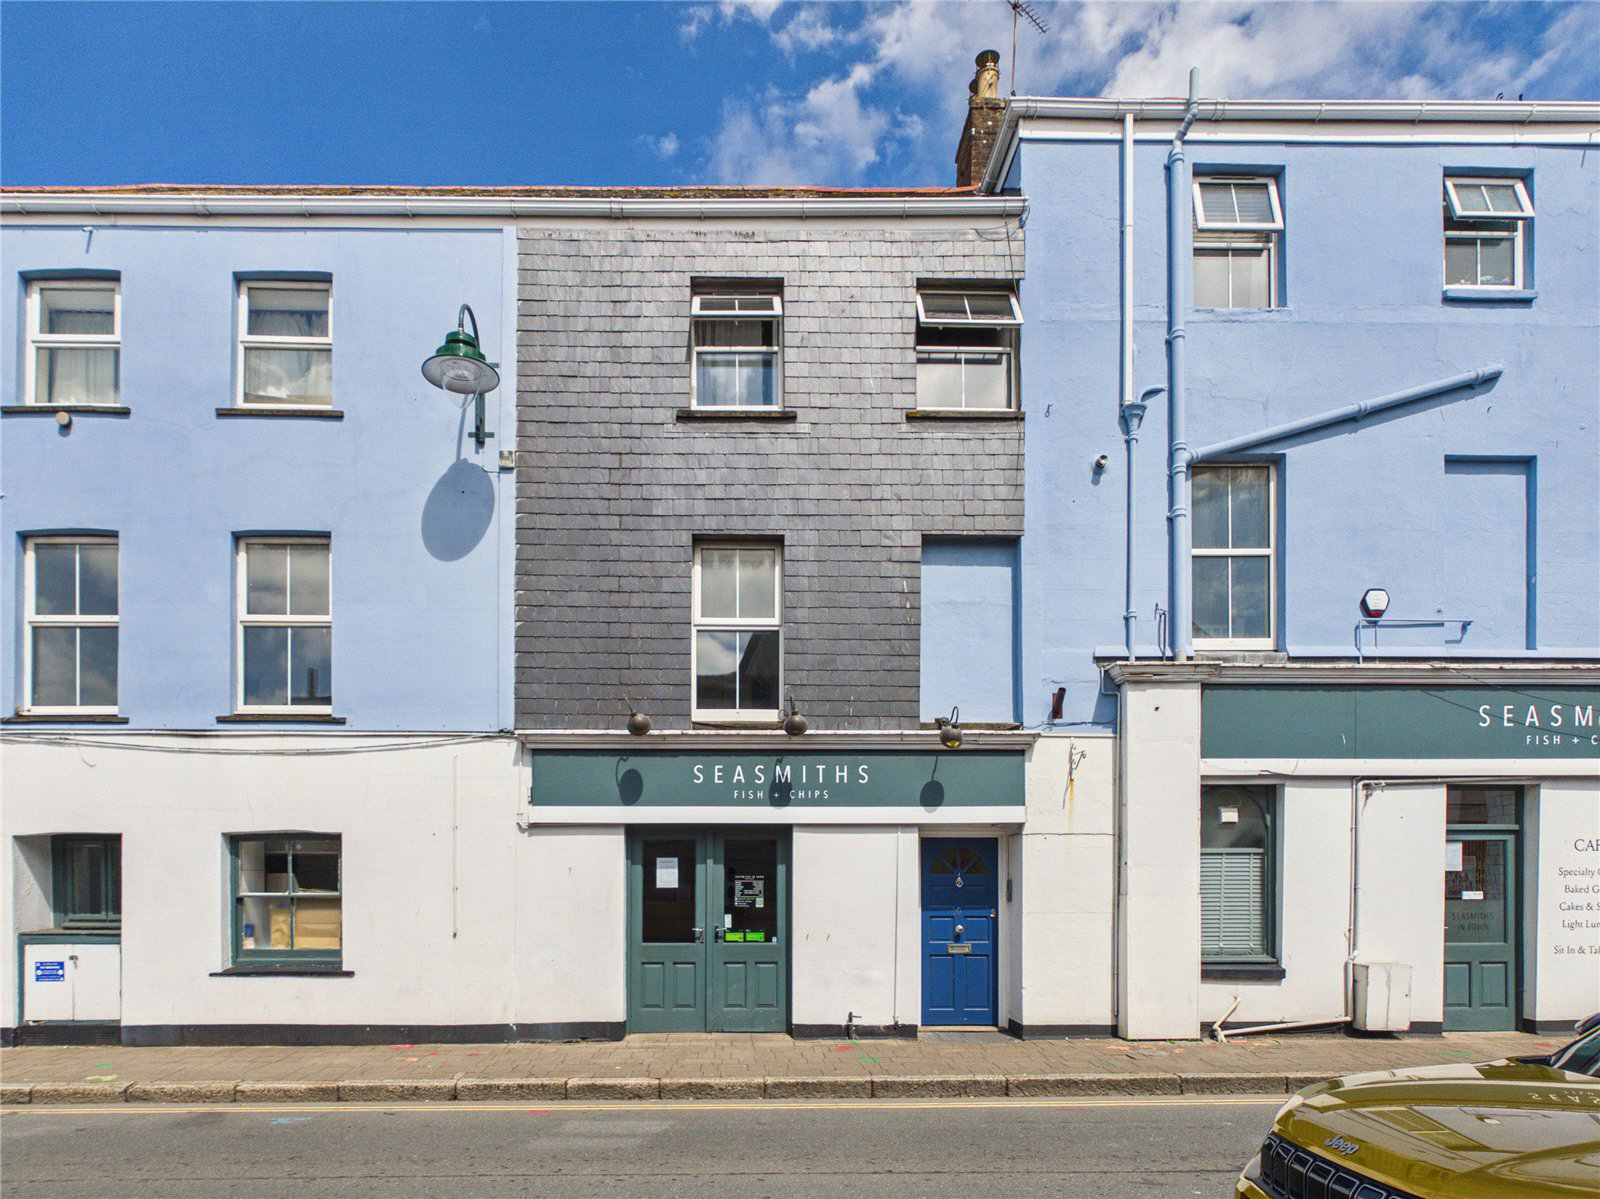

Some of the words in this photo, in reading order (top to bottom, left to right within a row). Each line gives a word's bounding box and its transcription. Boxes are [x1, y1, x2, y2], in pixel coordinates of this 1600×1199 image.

[1526, 735, 1561, 745] FISH
[693, 764, 870, 784] SEASMITHS
[733, 789, 765, 800] FISH
[789, 789, 830, 800] CHIPS
[1557, 867, 1596, 879] Specialty
[1564, 884, 1589, 894] Baked
[1558, 902, 1584, 911] Cakes
[1585, 902, 1594, 911] &
[1562, 919, 1583, 931] Light
[1553, 945, 1565, 955] Sit
[1567, 945, 1575, 954] In
[1577, 945, 1586, 954] &
[1323, 1134, 1360, 1156] Jeep
